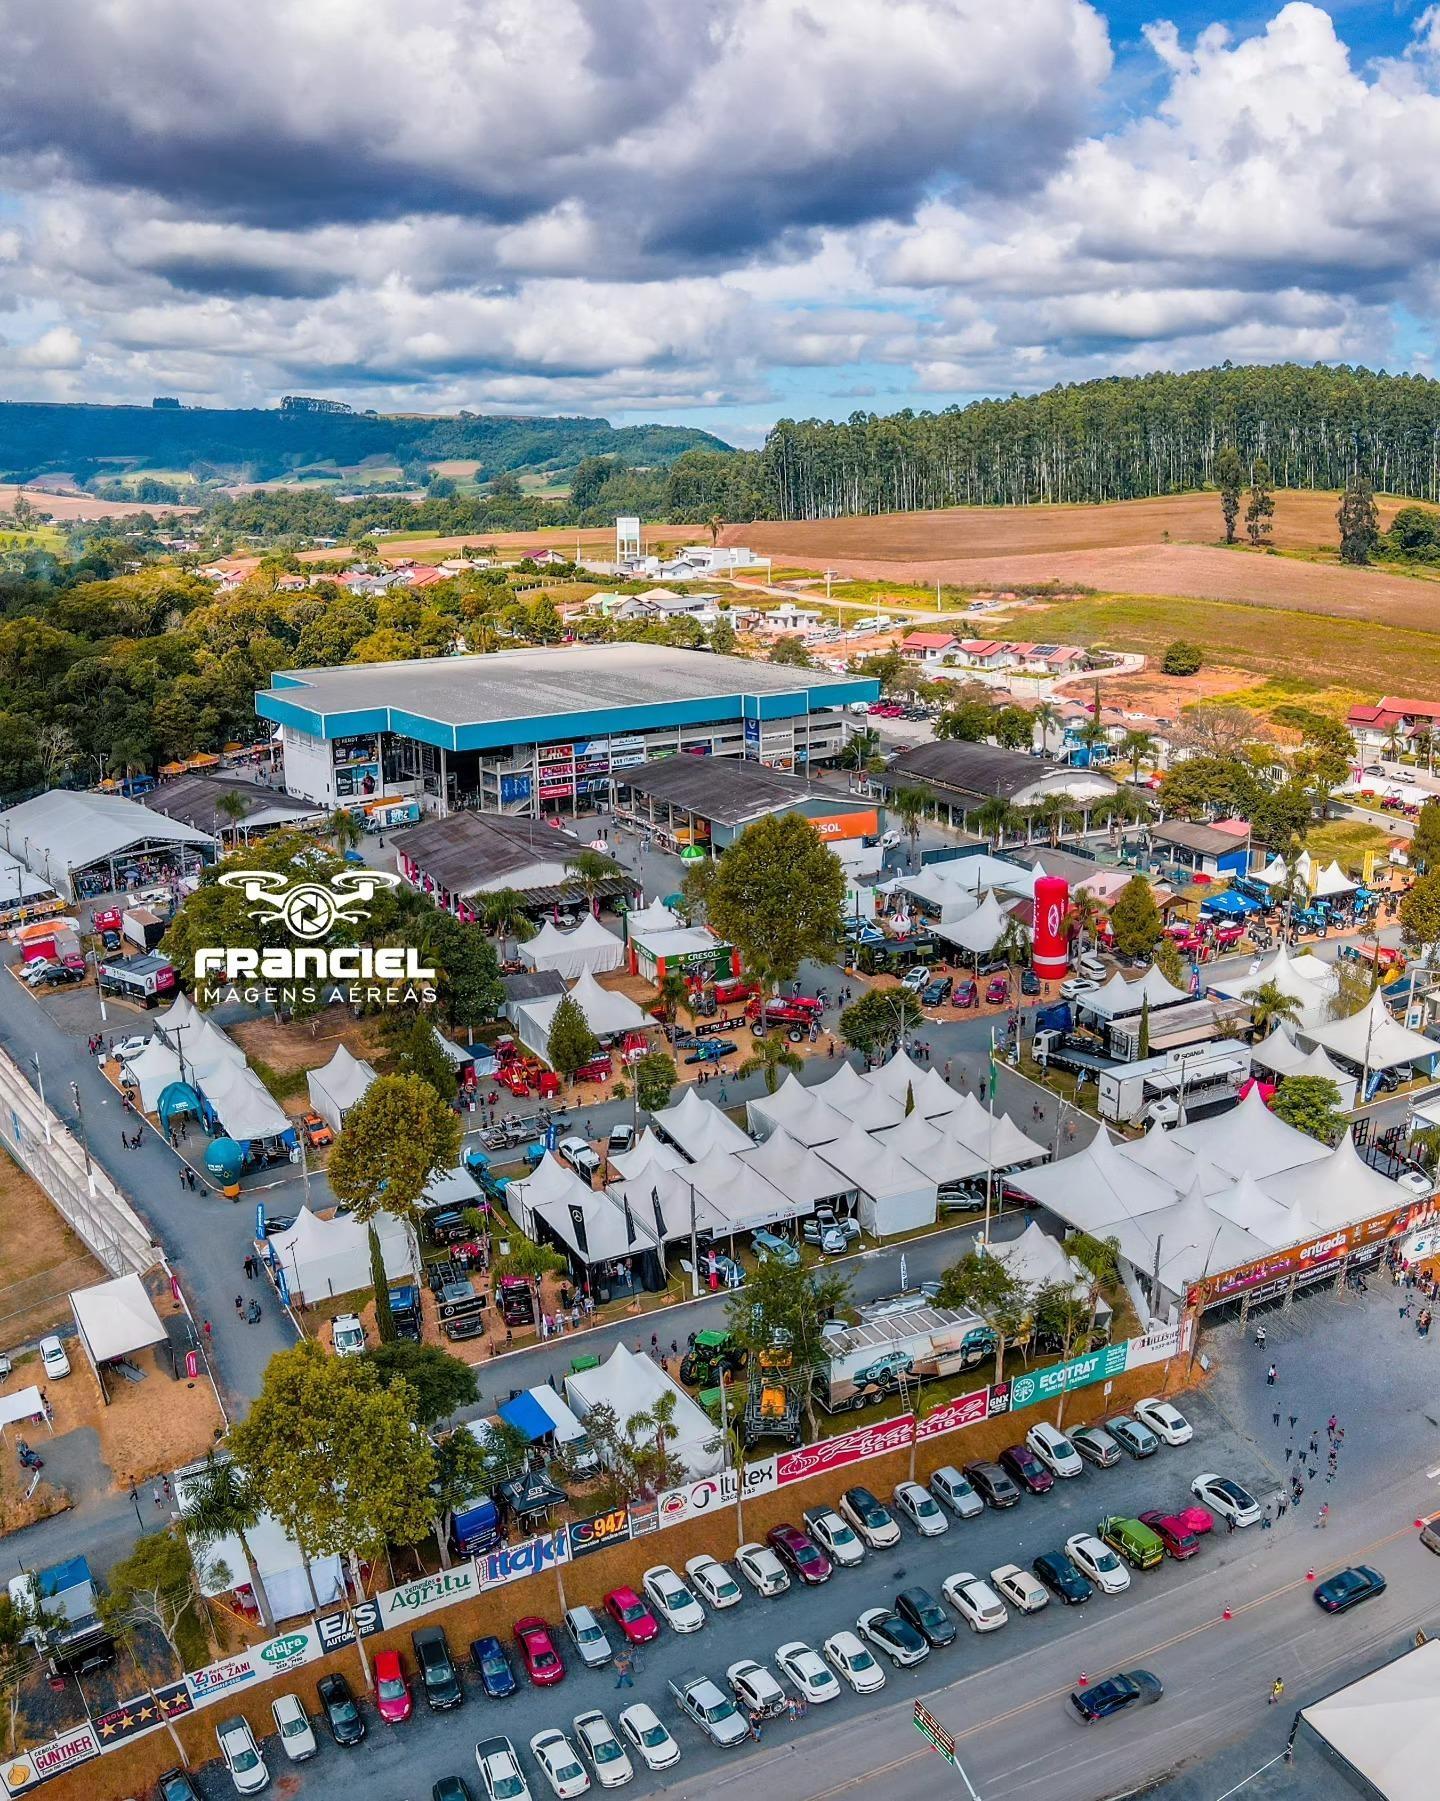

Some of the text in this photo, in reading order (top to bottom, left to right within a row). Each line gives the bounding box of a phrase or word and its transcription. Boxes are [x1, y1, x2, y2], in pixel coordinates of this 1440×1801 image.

[687, 950, 718, 961] CRESOL
[1300, 1232, 1346, 1260] entrada
[1039, 1357, 1100, 1389] ECOTRAT
[859, 1410, 982, 1455] CEREALISTA
[721, 1486, 756, 1503] Sacaias
[388, 1573, 472, 1612] Agritu
[208, 1661, 236, 1675] Mercado
[210, 1661, 251, 1684] DA ZANI
[34, 1743, 59, 1757] CEBOLAS
[35, 1735, 93, 1769] GUNTHER
